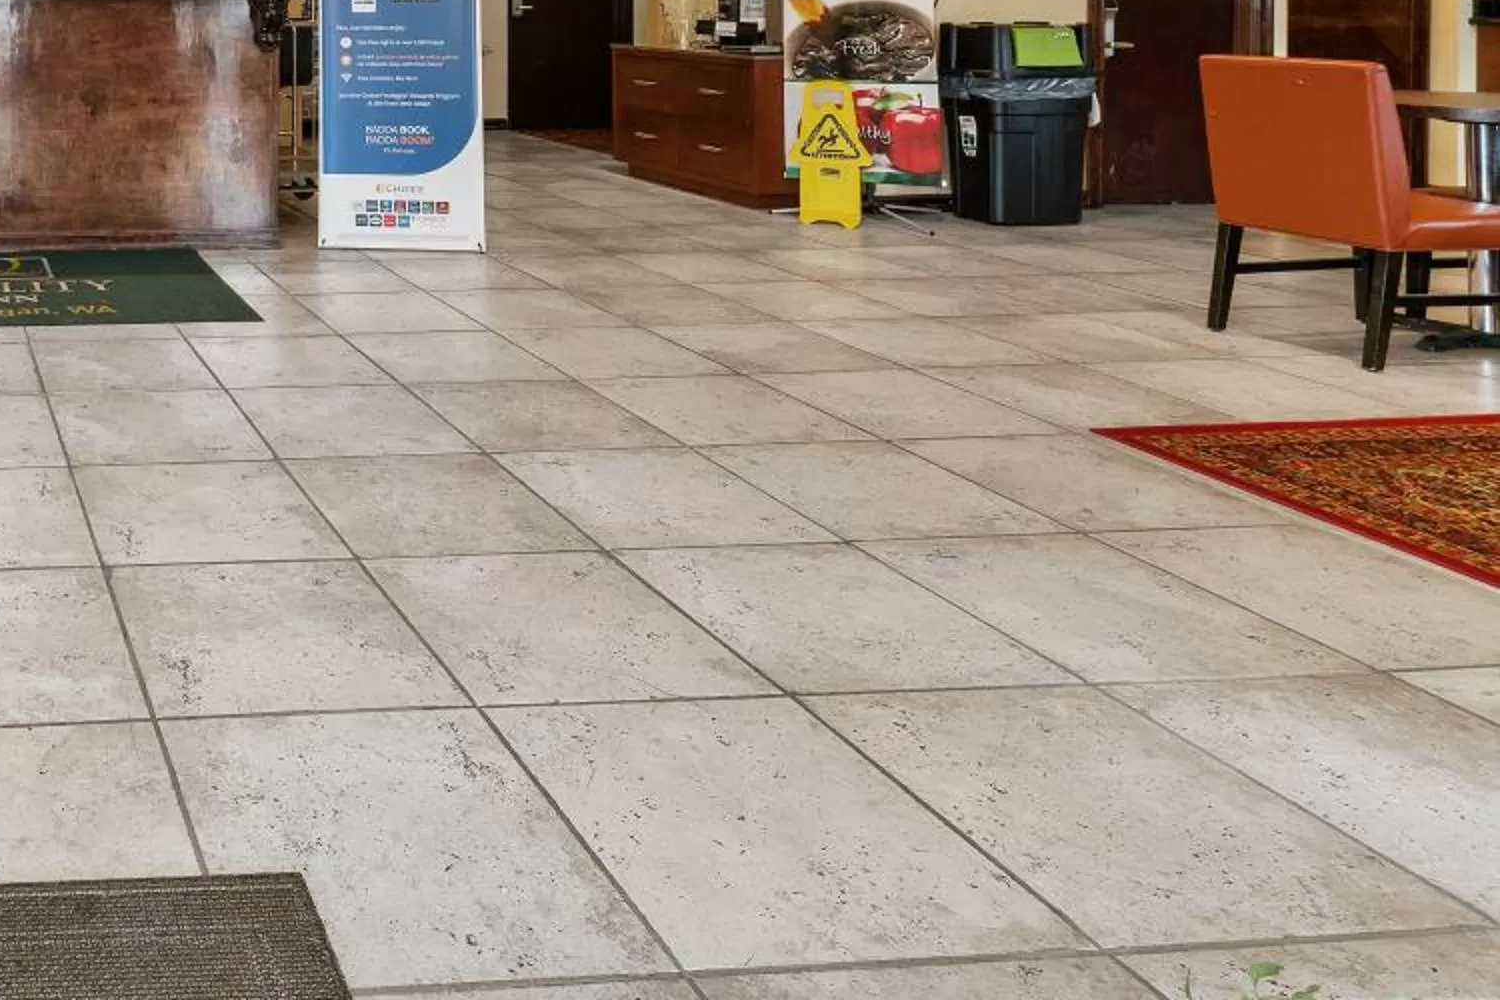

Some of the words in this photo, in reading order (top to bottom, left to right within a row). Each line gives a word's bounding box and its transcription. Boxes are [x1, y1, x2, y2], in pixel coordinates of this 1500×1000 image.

[836, 36, 882, 56] Fresh
[857, 125, 891, 145] lthy
[67, 304, 117, 315] WA
